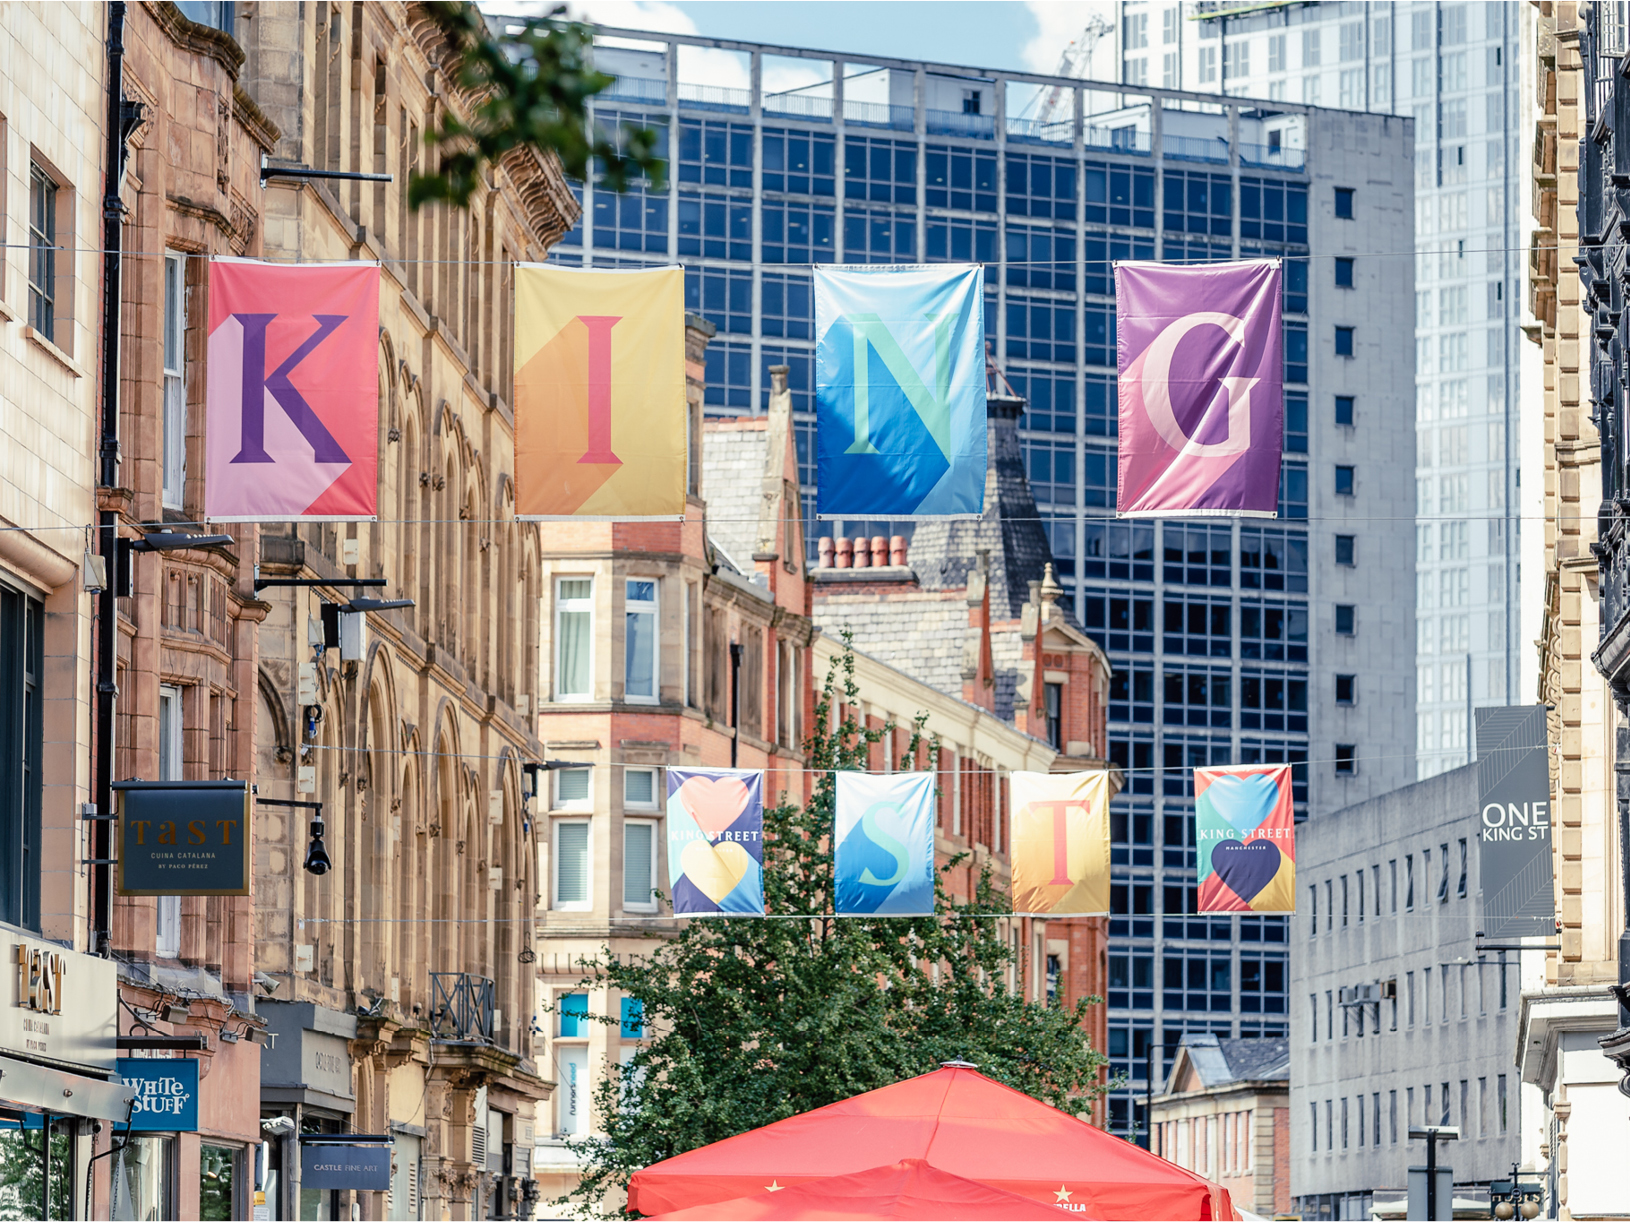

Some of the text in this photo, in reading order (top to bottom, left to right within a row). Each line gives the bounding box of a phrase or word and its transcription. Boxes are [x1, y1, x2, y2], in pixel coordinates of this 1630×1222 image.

[228, 312, 353, 464] K
[575, 315, 624, 464] I
[843, 312, 961, 465] N
[1142, 311, 1261, 458] G
[671, 829, 759, 841] KING STREET
[858, 801, 910, 887] S
[1028, 799, 1091, 886] T
[1200, 828, 1290, 839] KING STREET
[1482, 801, 1549, 828] ONE
[1482, 826, 1549, 842] KING ST
[344, 1164, 361, 1172] FINE
